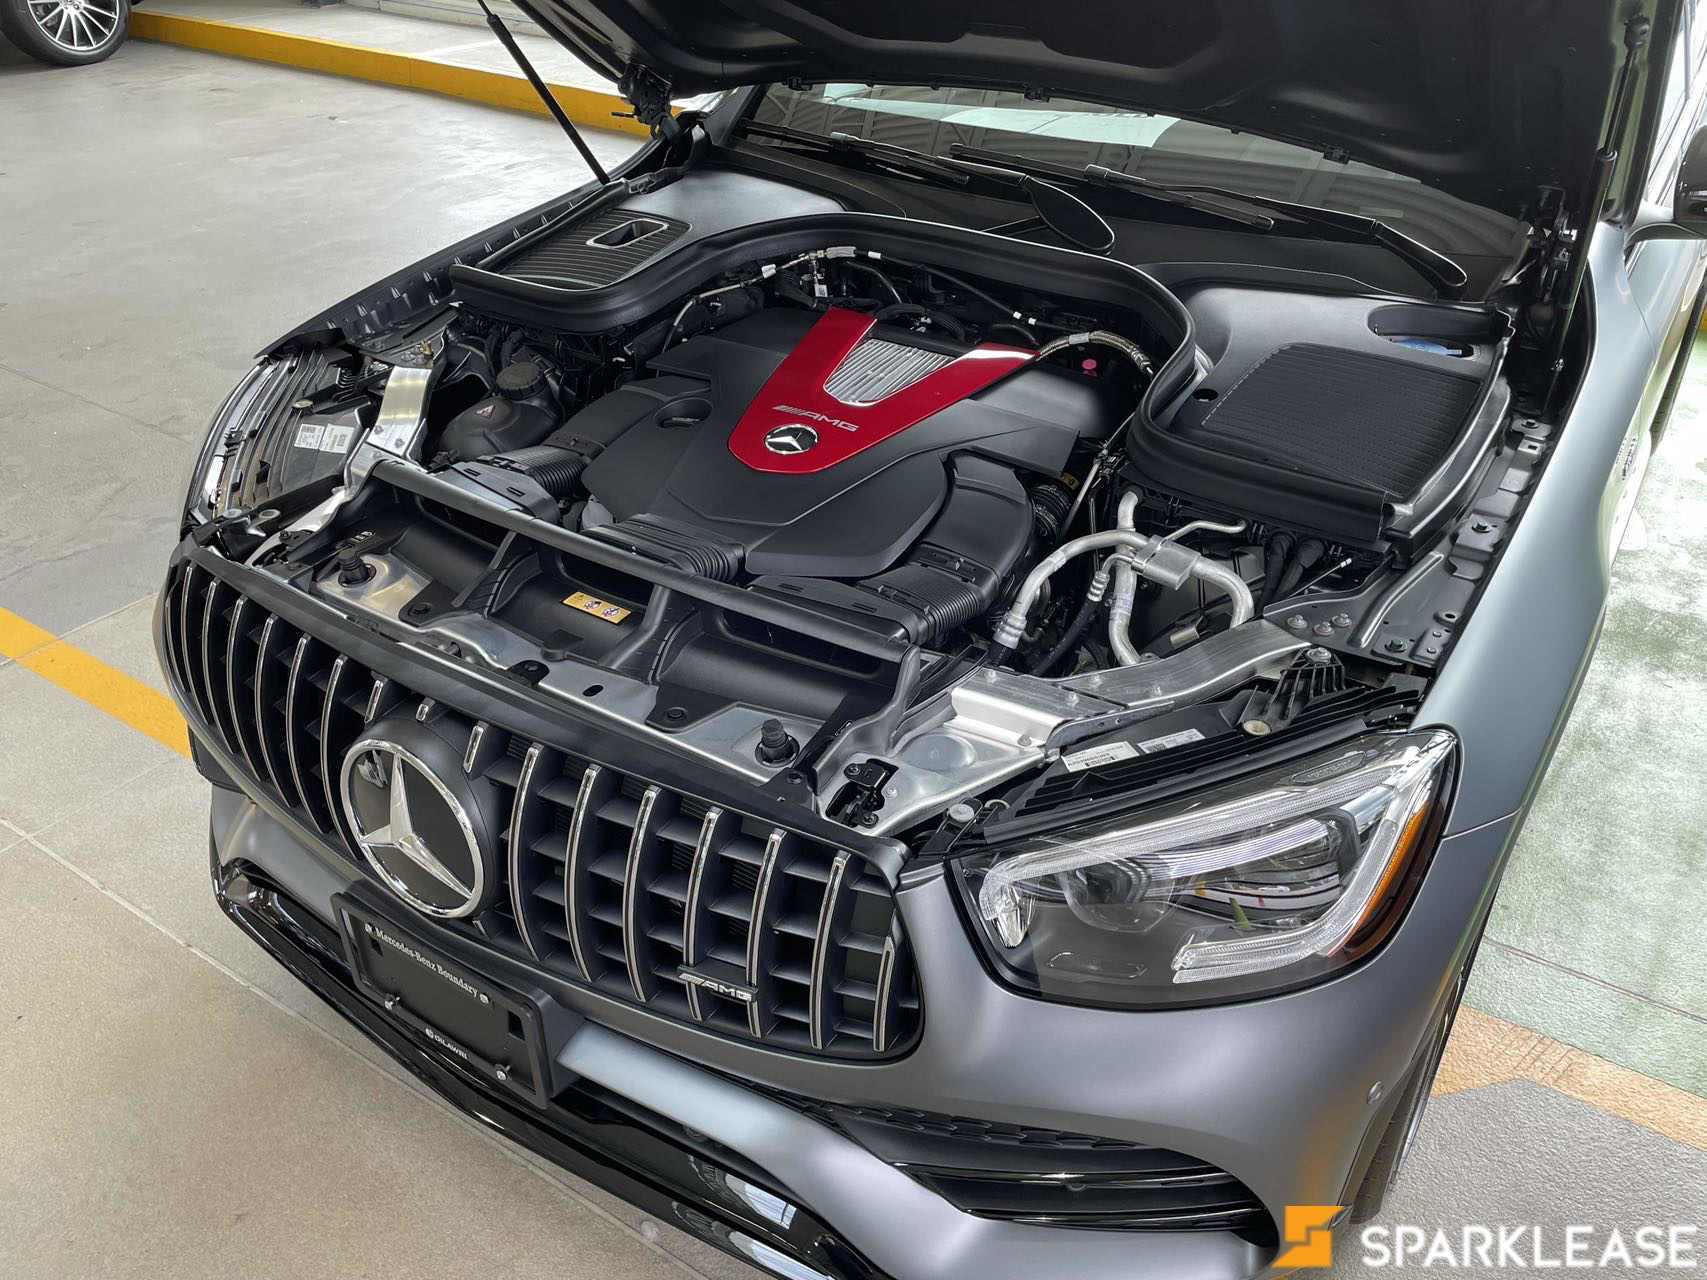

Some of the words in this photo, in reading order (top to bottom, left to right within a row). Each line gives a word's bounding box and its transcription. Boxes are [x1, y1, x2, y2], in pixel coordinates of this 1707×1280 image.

[798, 411, 862, 433] AMG
[374, 926, 437, 972] Mercedes-Benz
[436, 963, 479, 998] Boundary
[701, 979, 753, 1002] AMG
